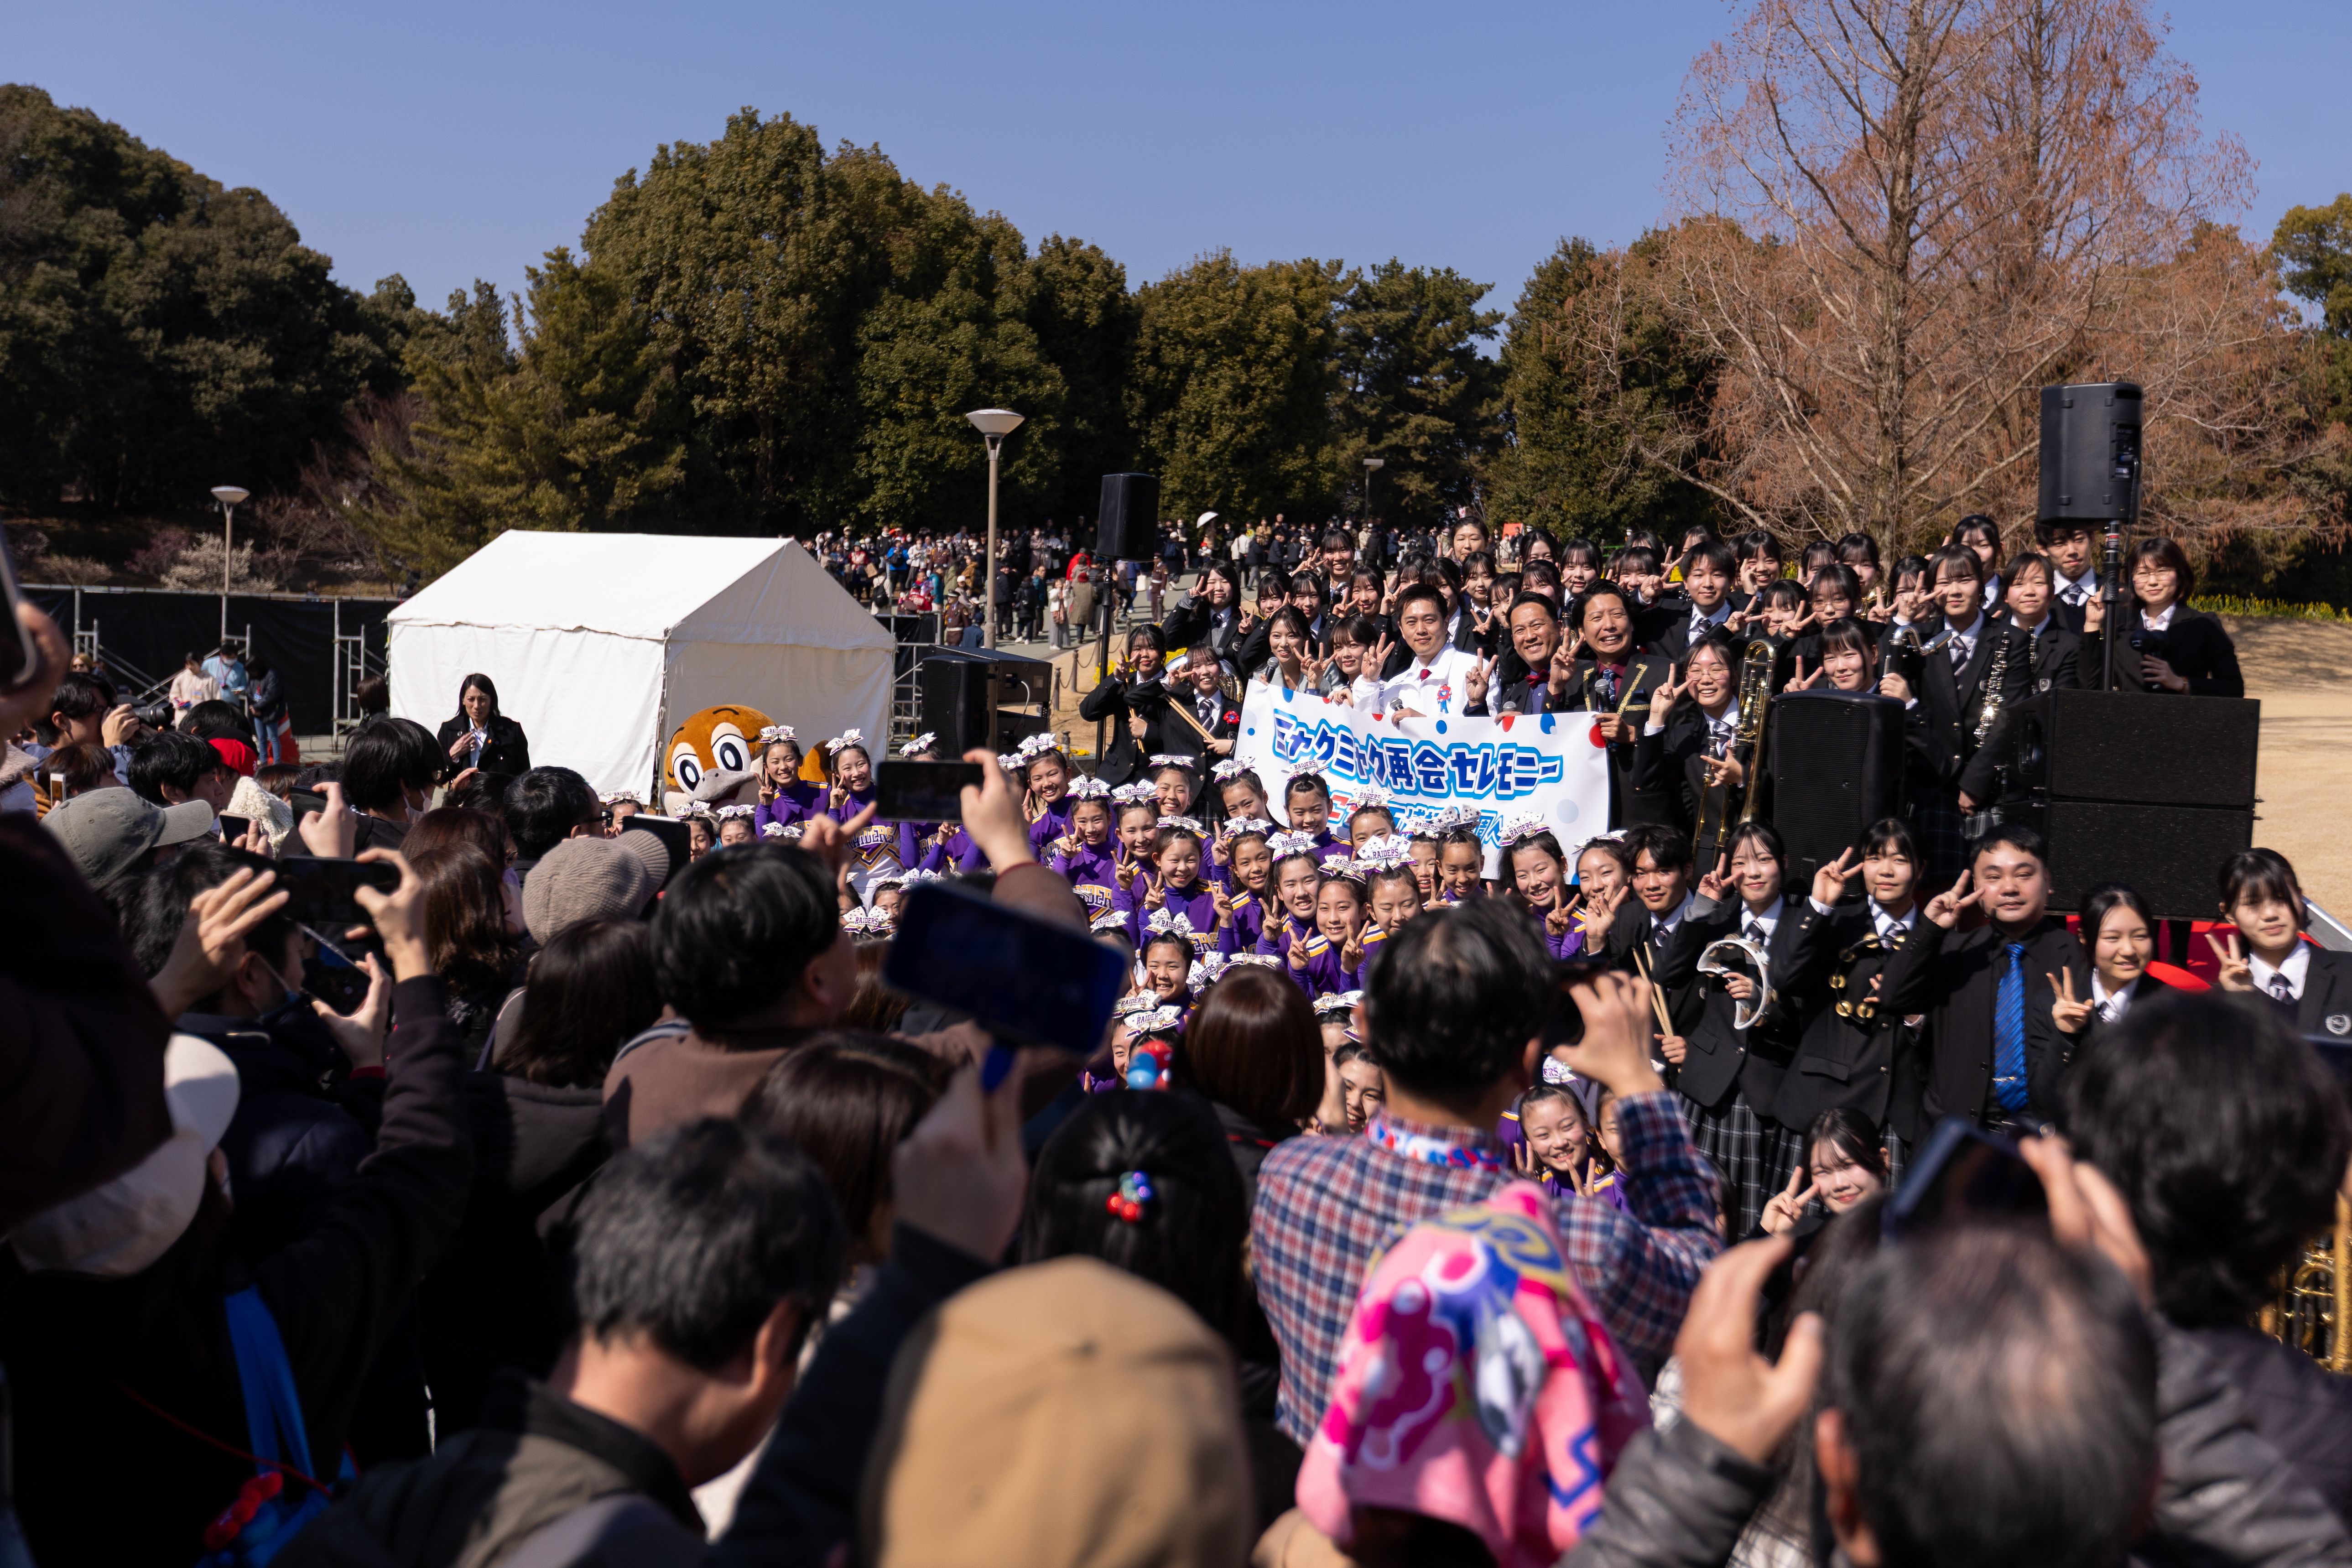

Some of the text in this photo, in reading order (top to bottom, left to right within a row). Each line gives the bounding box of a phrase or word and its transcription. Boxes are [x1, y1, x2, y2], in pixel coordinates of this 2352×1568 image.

[1223, 761, 1243, 769] RAIDERS
[1294, 761, 1316, 770] RAIDERS
[1125, 787, 1146, 796] RAIDERS
[1358, 792, 1381, 801] RAIDERS
[1171, 816, 1192, 824] RAIDERS
[1450, 822, 1473, 832] RAIDERS
[1509, 822, 1534, 838] RAIDERS
[847, 825, 894, 849] AIDERS
[1281, 837, 1305, 848] RAIDERS
[1373, 849, 1399, 860] RAIDERS
[1334, 859, 1358, 870] RAIDERS
[1096, 916, 1115, 926] RAIDERS
[1161, 920, 1184, 932] RAIDERS
[1196, 964, 1217, 984] RAIDERS
[1121, 997, 1145, 1006] RAIDERS
[1137, 1012, 1163, 1025] RAIDERS
